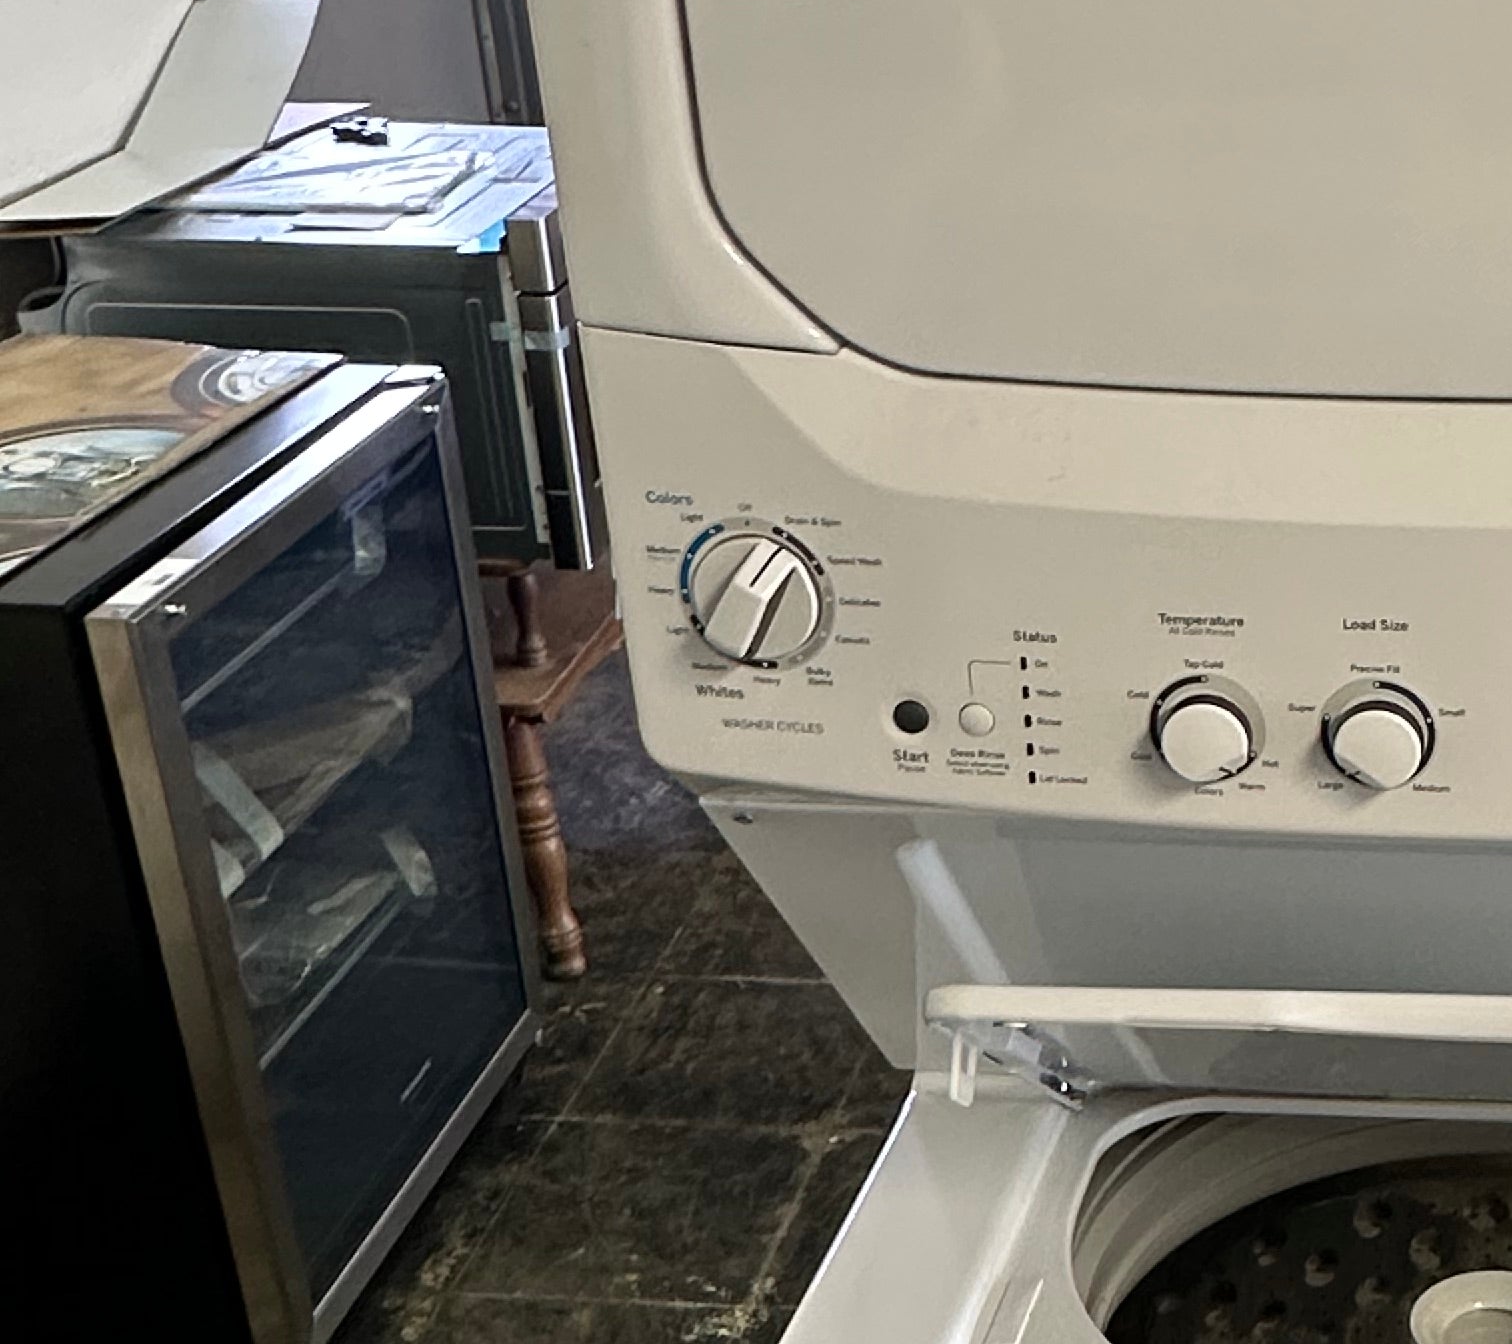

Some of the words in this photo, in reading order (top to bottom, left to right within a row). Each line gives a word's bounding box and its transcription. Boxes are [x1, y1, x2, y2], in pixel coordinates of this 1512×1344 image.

[645, 490, 693, 506] Colors
[1158, 613, 1244, 629] Temperature
[1342, 618, 1376, 632] Load
[1379, 618, 1409, 632] Size
[1013, 630, 1058, 644] Status
[694, 683, 744, 699] Whites
[722, 718, 774, 732] WASHER
[776, 720, 824, 735] CYCLES
[893, 748, 930, 764] Start
